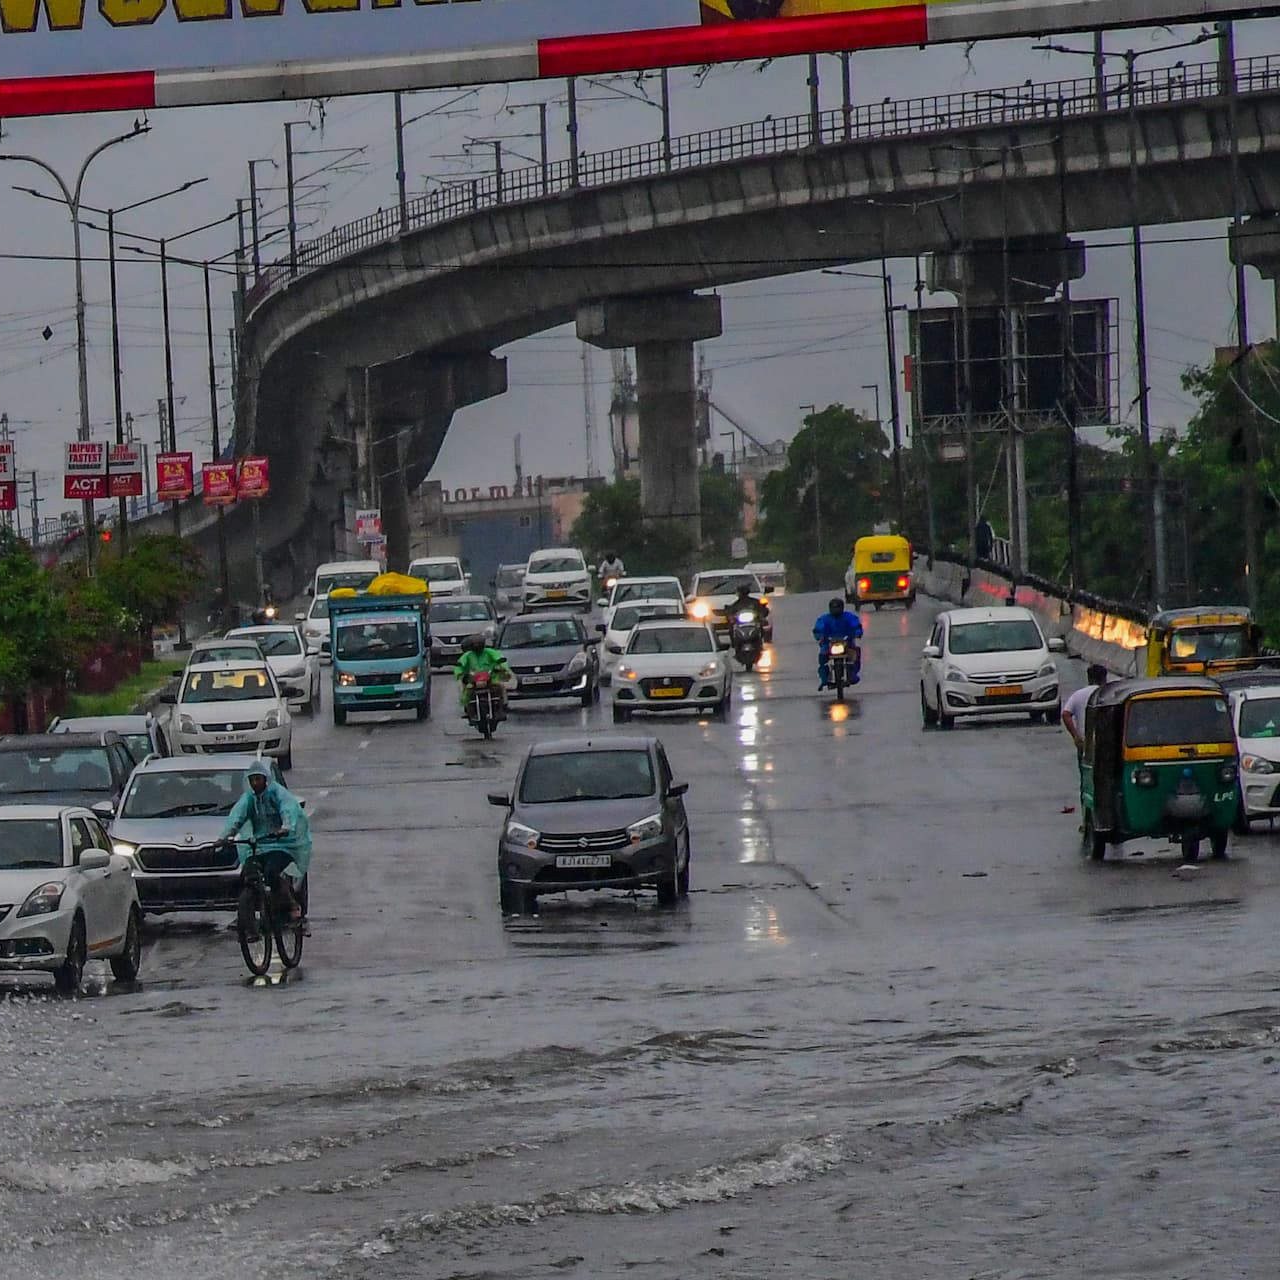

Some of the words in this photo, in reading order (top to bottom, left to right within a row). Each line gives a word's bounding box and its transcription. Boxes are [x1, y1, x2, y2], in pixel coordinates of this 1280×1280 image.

[69, 453, 102, 463] FASTEST
[70, 478, 101, 490] ACT
[113, 475, 133, 484] ACT
